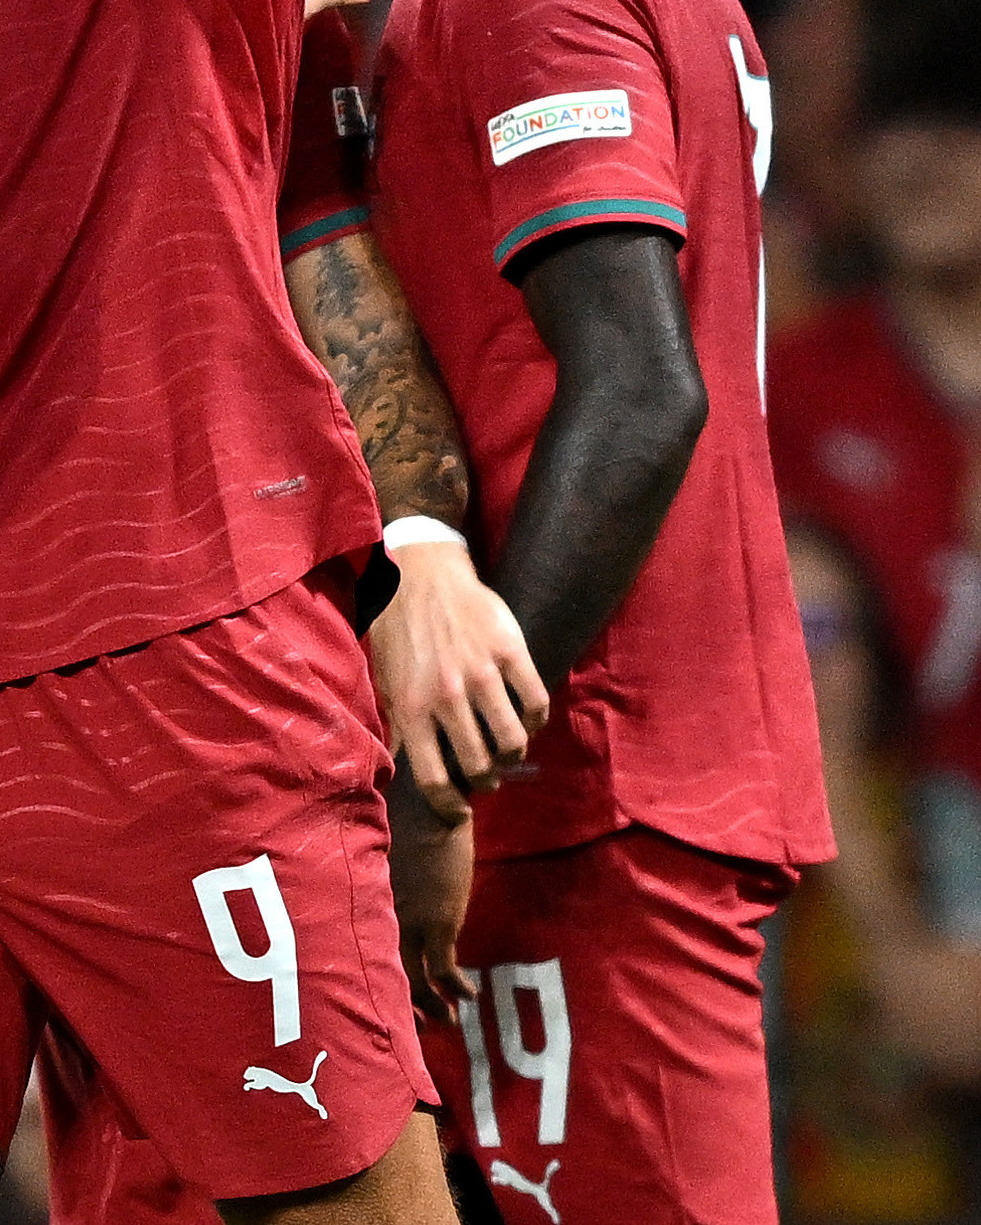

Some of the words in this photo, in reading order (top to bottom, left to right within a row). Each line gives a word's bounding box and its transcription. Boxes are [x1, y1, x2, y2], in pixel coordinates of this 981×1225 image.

[492, 105, 626, 149] FOUNDATION
[192, 853, 301, 1047] 9
[458, 958, 572, 1148] 19
